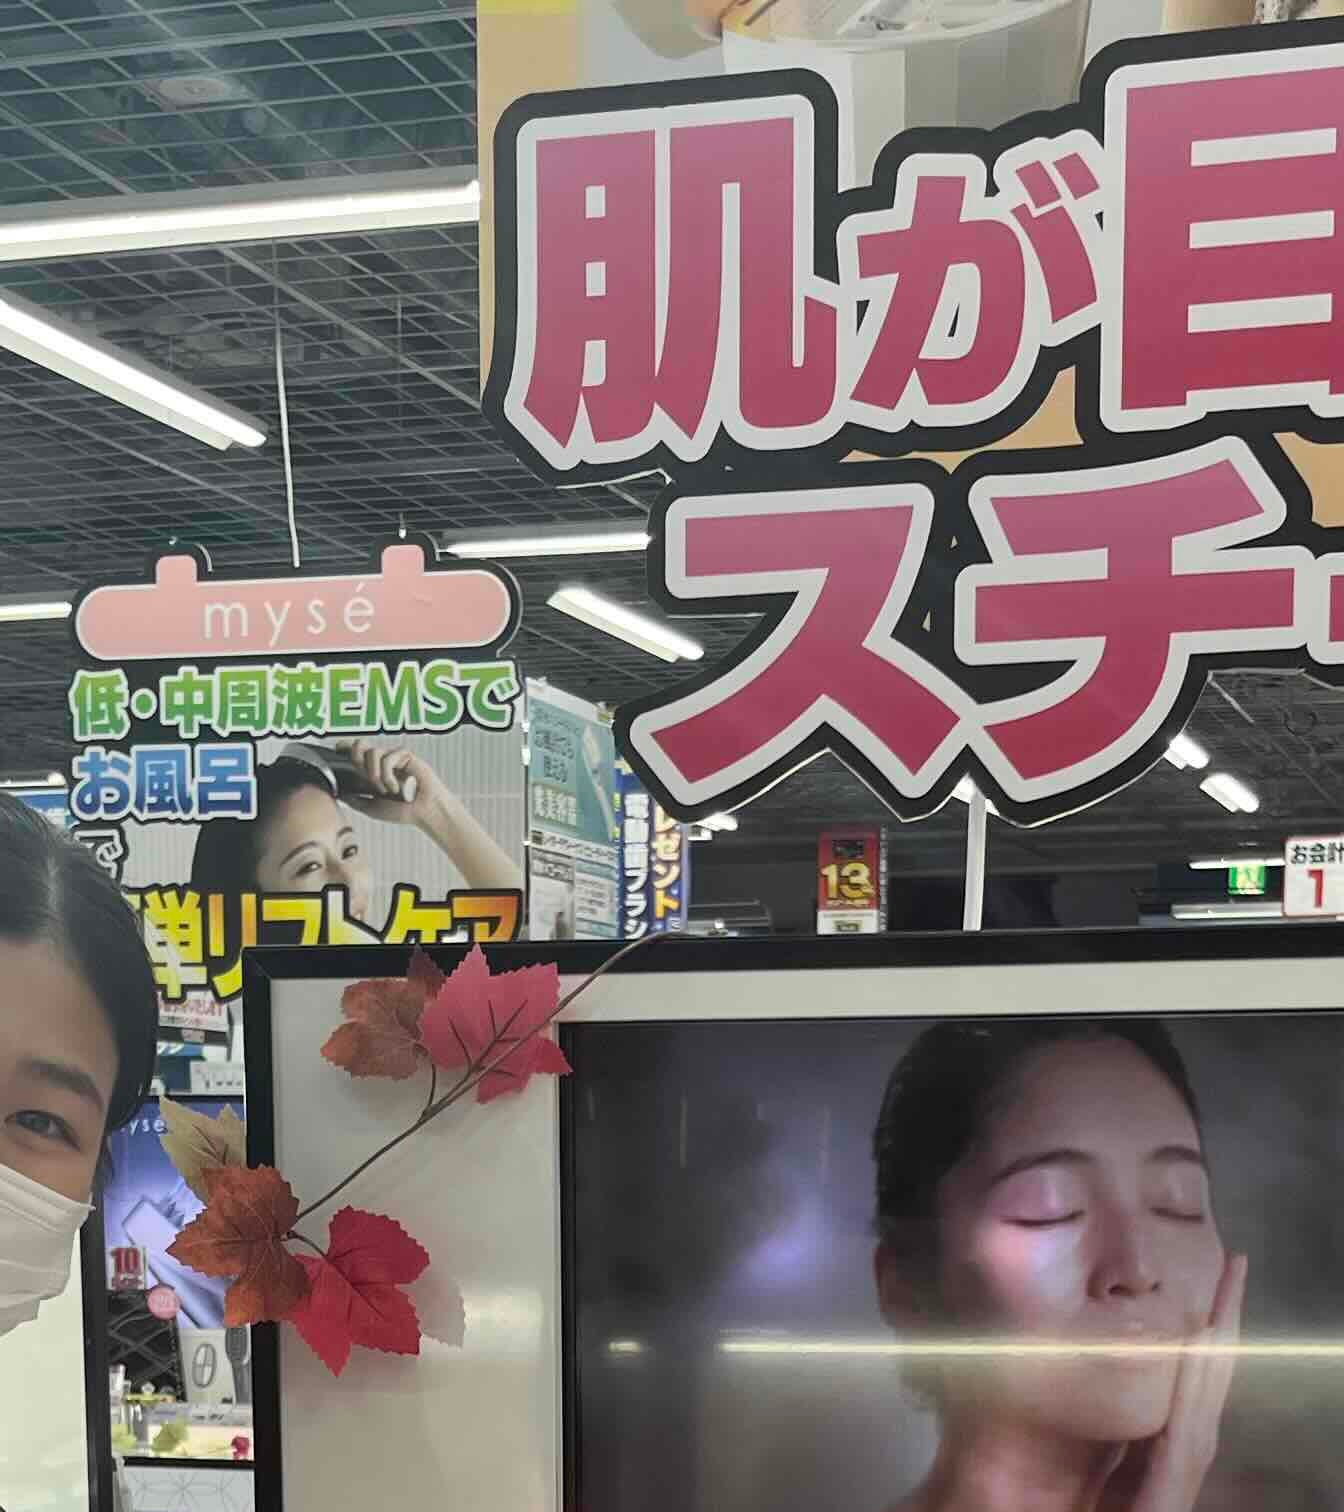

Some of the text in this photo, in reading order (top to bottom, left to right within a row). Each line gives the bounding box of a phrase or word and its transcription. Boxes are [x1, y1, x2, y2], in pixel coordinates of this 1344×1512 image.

[203, 583, 376, 648] mysé
[69, 659, 523, 741] 低・中周波EMSで
[70, 742, 259, 822] お風呂
[1307, 869, 1324, 911] 1
[126, 886, 524, 1000] 単リフトケア
